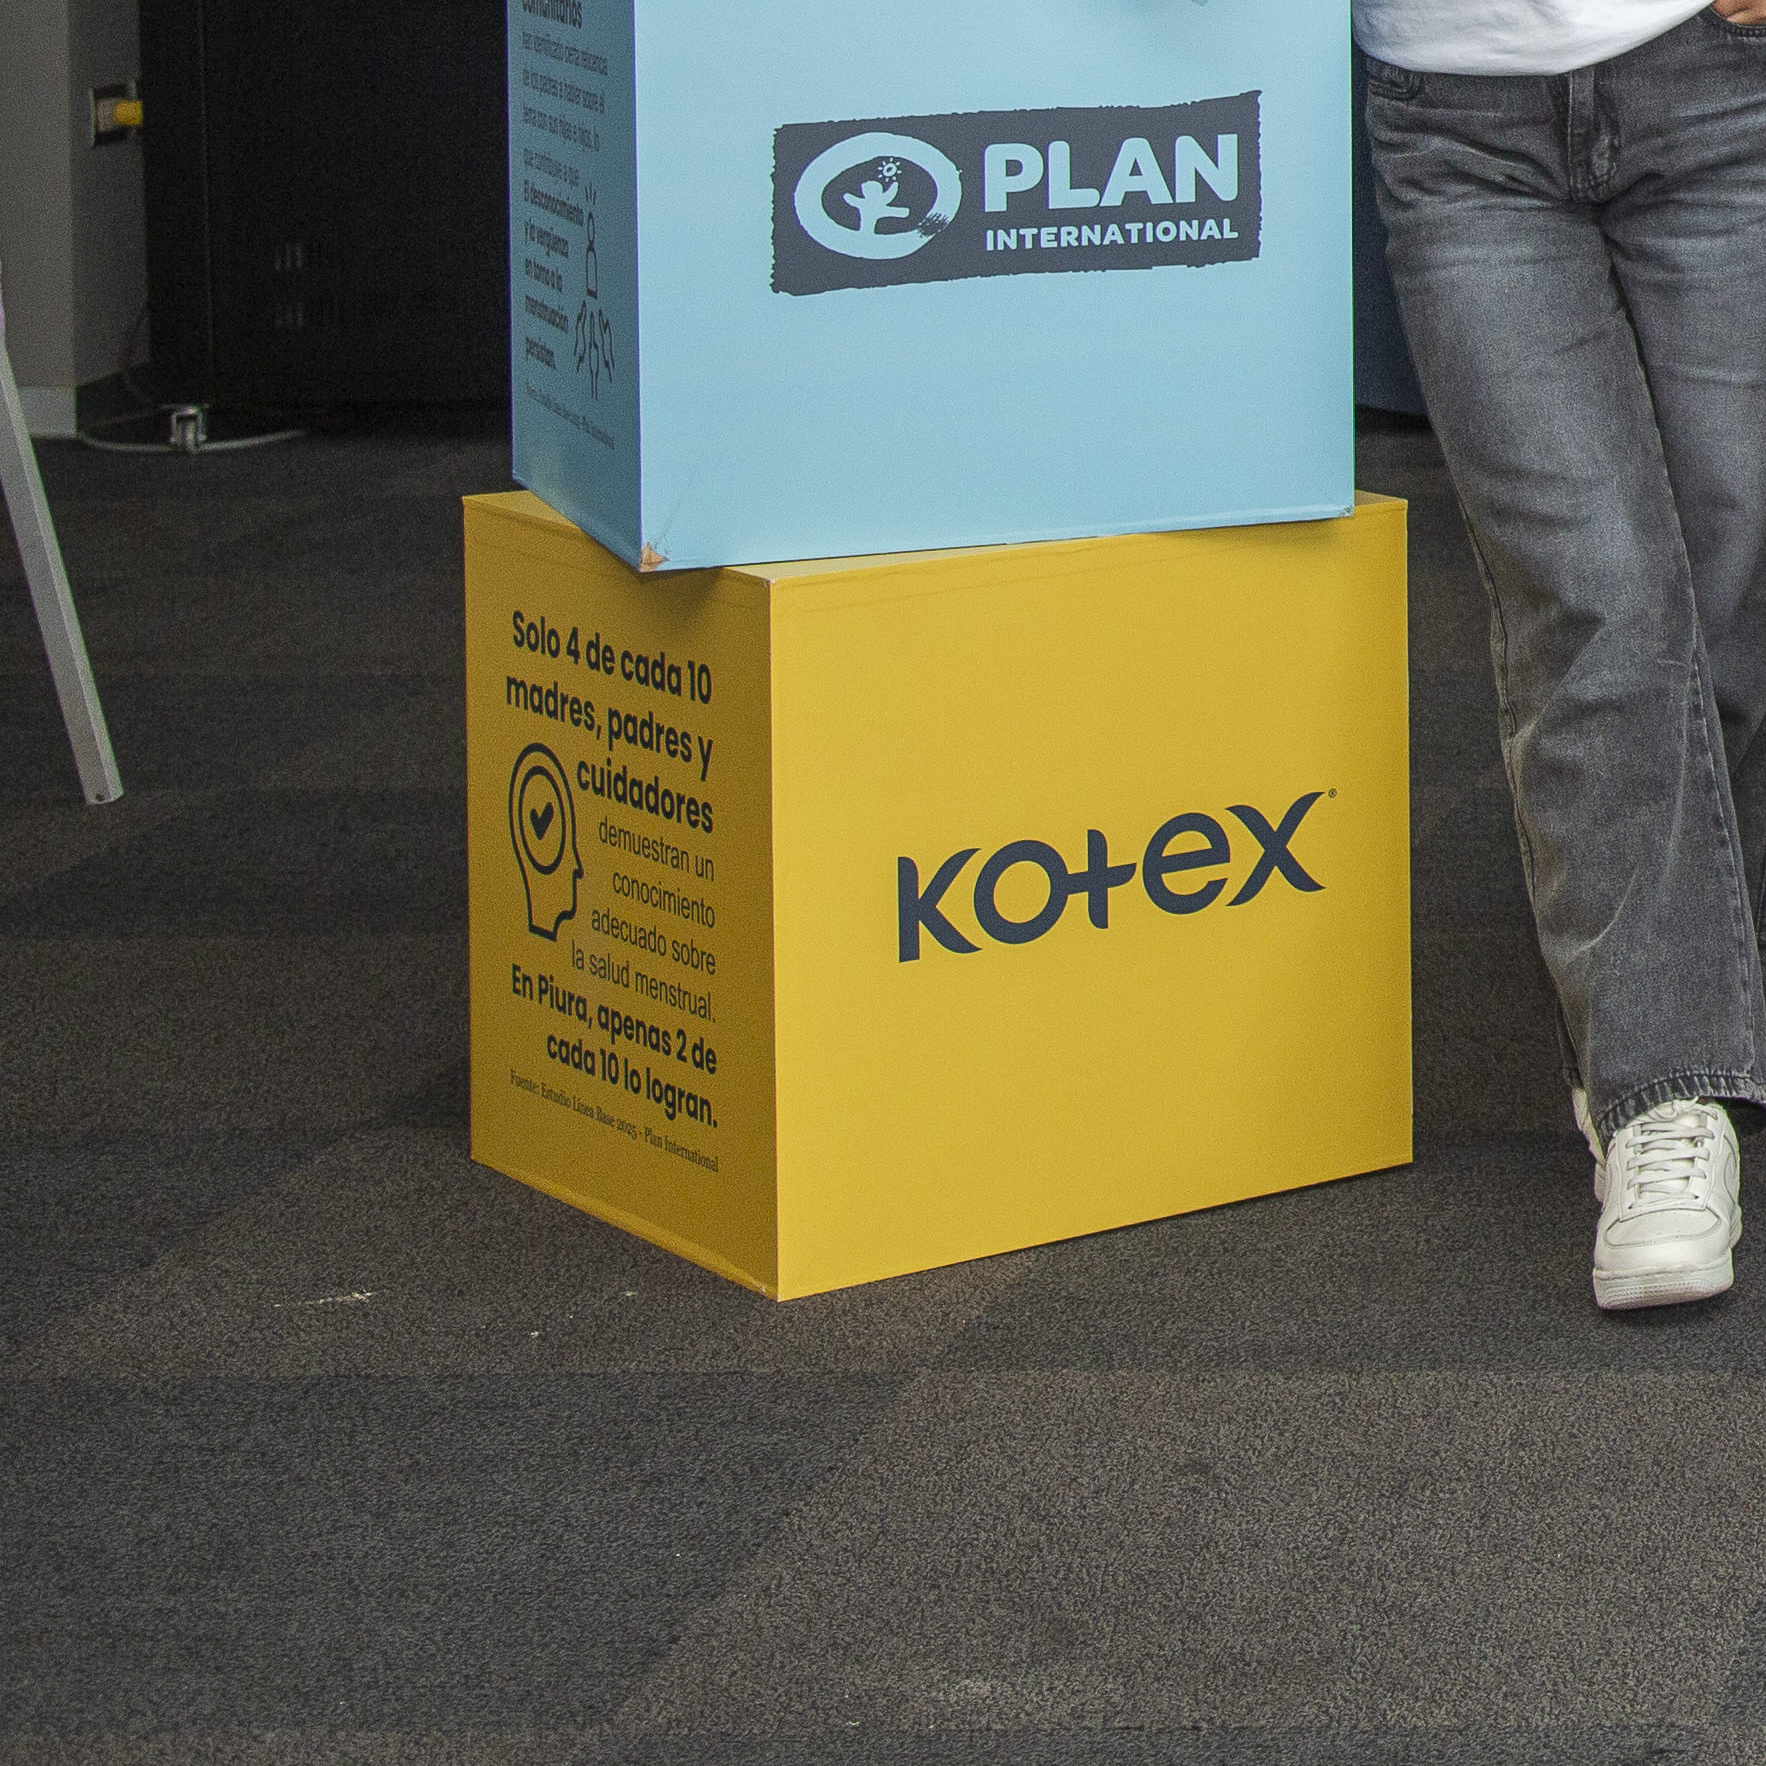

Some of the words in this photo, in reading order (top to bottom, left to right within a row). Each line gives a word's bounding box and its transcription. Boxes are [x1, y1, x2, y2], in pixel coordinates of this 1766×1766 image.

[984, 133, 1239, 212] PLAN
[985, 218, 1240, 252] INTERNATIONAL
[512, 610, 561, 658] Solo
[566, 626, 581, 665] 4
[585, 632, 615, 675] de
[620, 650, 682, 696] cada
[687, 660, 712, 704] 10
[506, 675, 602, 741] madres,
[608, 707, 692, 763] padres
[698, 735, 713, 782] y
[576, 756, 714, 834] cuidadores
[599, 816, 690, 874] demuestran
[695, 853, 714, 882] un
[612, 872, 716, 929] conocimiento
[591, 907, 667, 957] adecuado
[671, 938, 716, 975] sobre
[511, 963, 534, 1001] En
[538, 973, 593, 1030] Piura,
[598, 1003, 673, 1057] apenas
[676, 1028, 688, 1063] 2
[691, 1036, 717, 1075] de
[571, 939, 585, 971] la
[589, 953, 630, 989] salud
[634, 971, 717, 1023] menstrual.
[546, 1034, 596, 1076] cada
[600, 1048, 620, 1085] 10
[623, 1057, 642, 1094] lo
[646, 1066, 718, 1129] logran.
